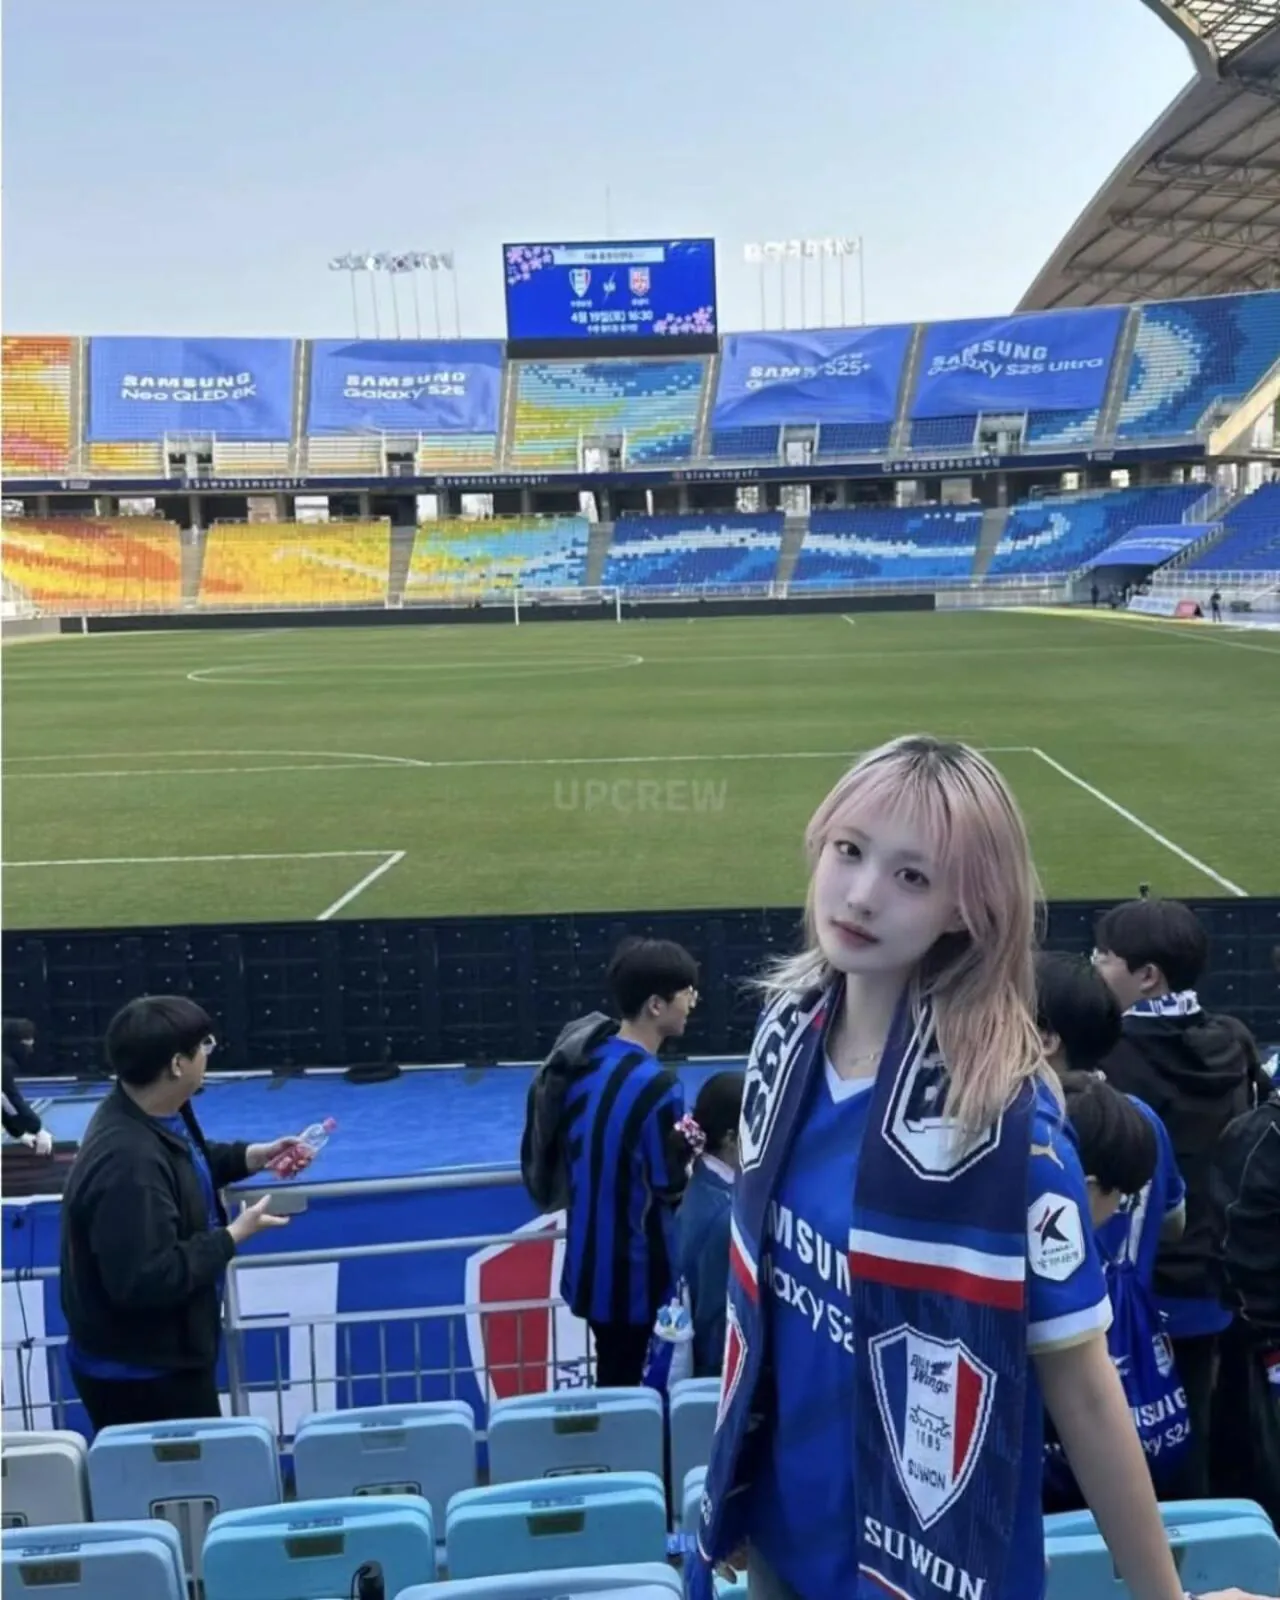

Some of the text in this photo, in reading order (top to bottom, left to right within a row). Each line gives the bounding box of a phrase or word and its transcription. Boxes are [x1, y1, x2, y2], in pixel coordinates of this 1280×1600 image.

[932, 339, 1048, 367] SAMSUNG
[1048, 357, 1104, 372] Ultra
[122, 371, 250, 388] SAMSUNG
[346, 370, 465, 388] SAMSUNG
[121, 384, 257, 402] Neo QLED 8K
[343, 386, 424, 401] Galaxy
[864, 1515, 987, 1600] SUWON
